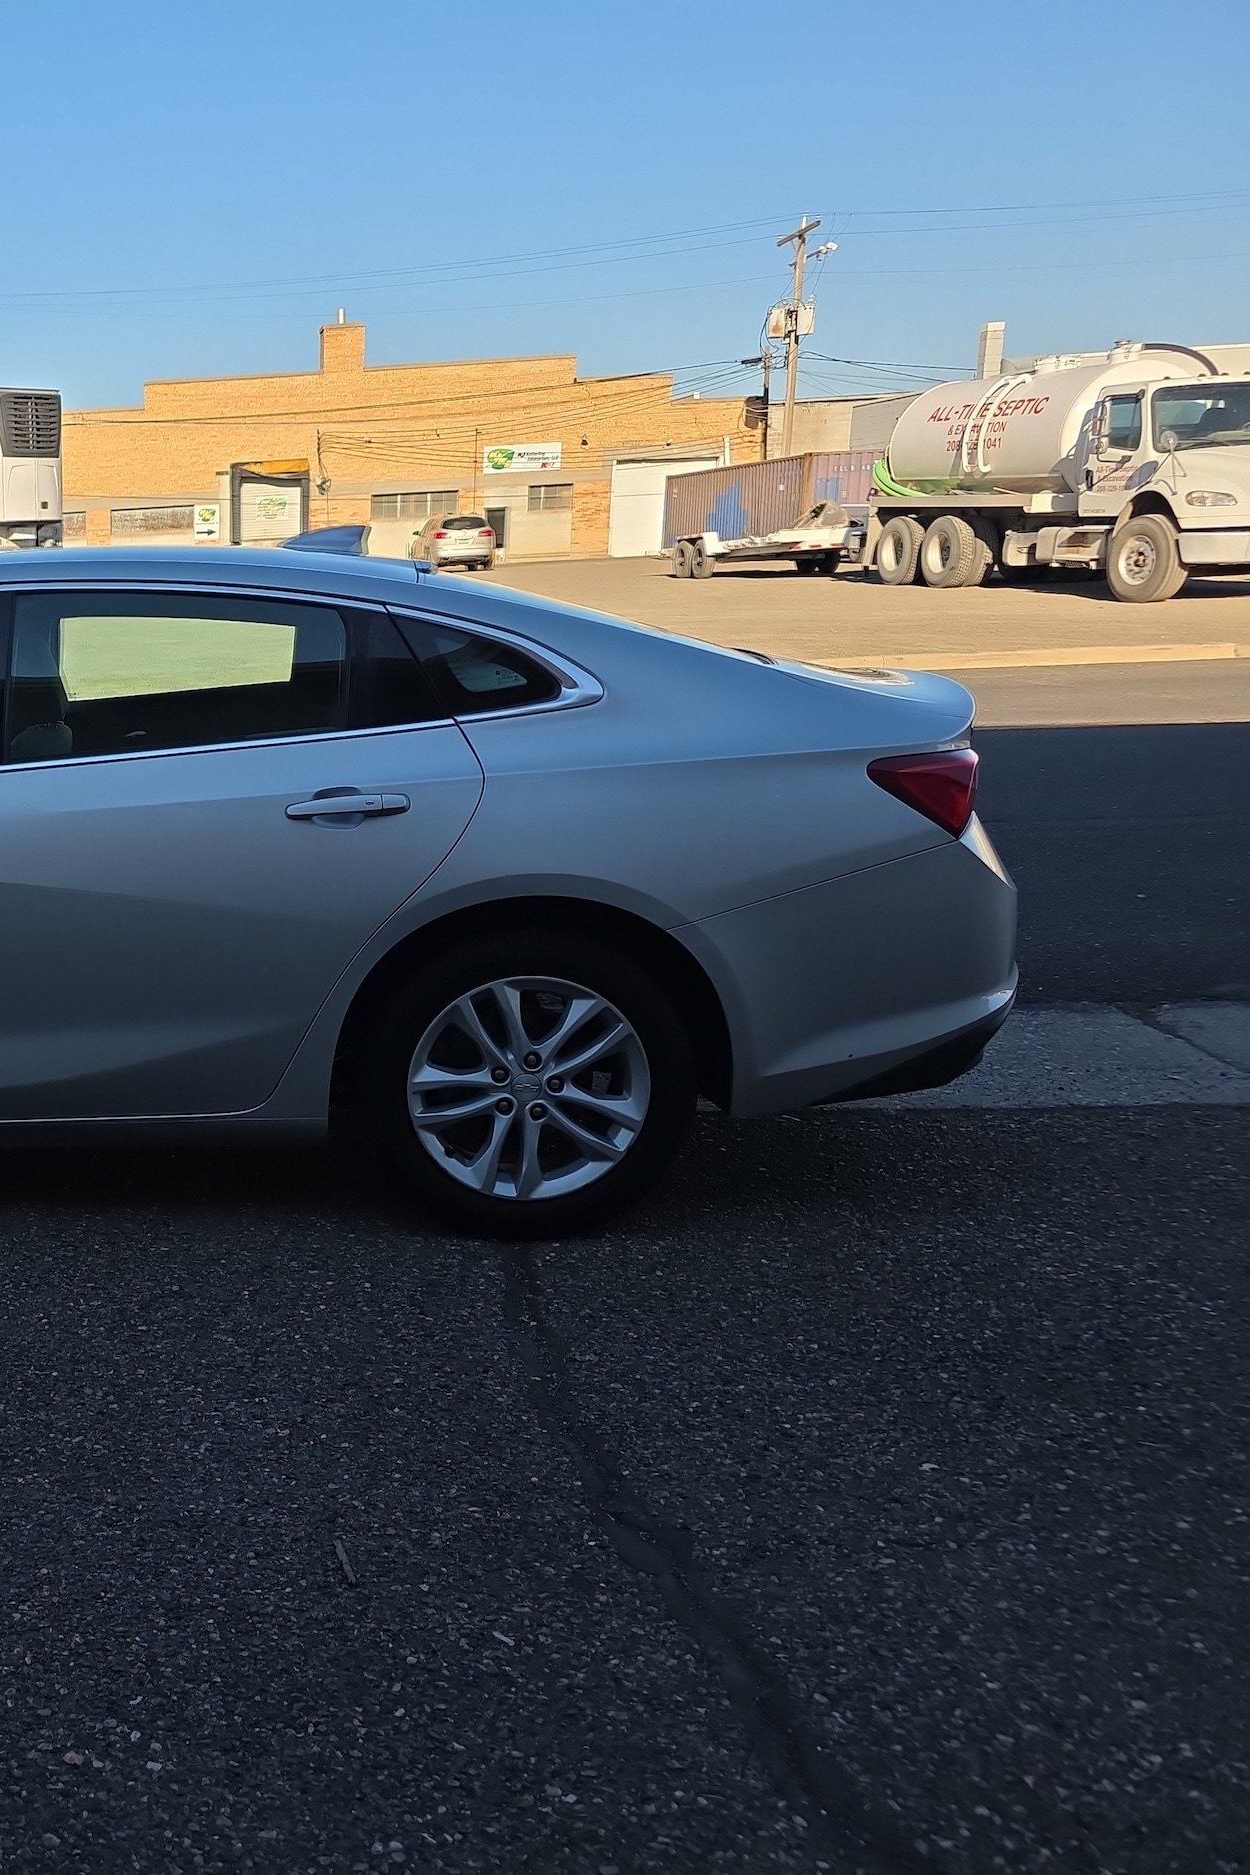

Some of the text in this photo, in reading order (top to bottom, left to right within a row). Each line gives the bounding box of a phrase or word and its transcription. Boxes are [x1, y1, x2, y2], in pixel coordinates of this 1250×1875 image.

[992, 397, 1050, 418] SEPTIC
[947, 421, 1008, 436] & EXAVTION
